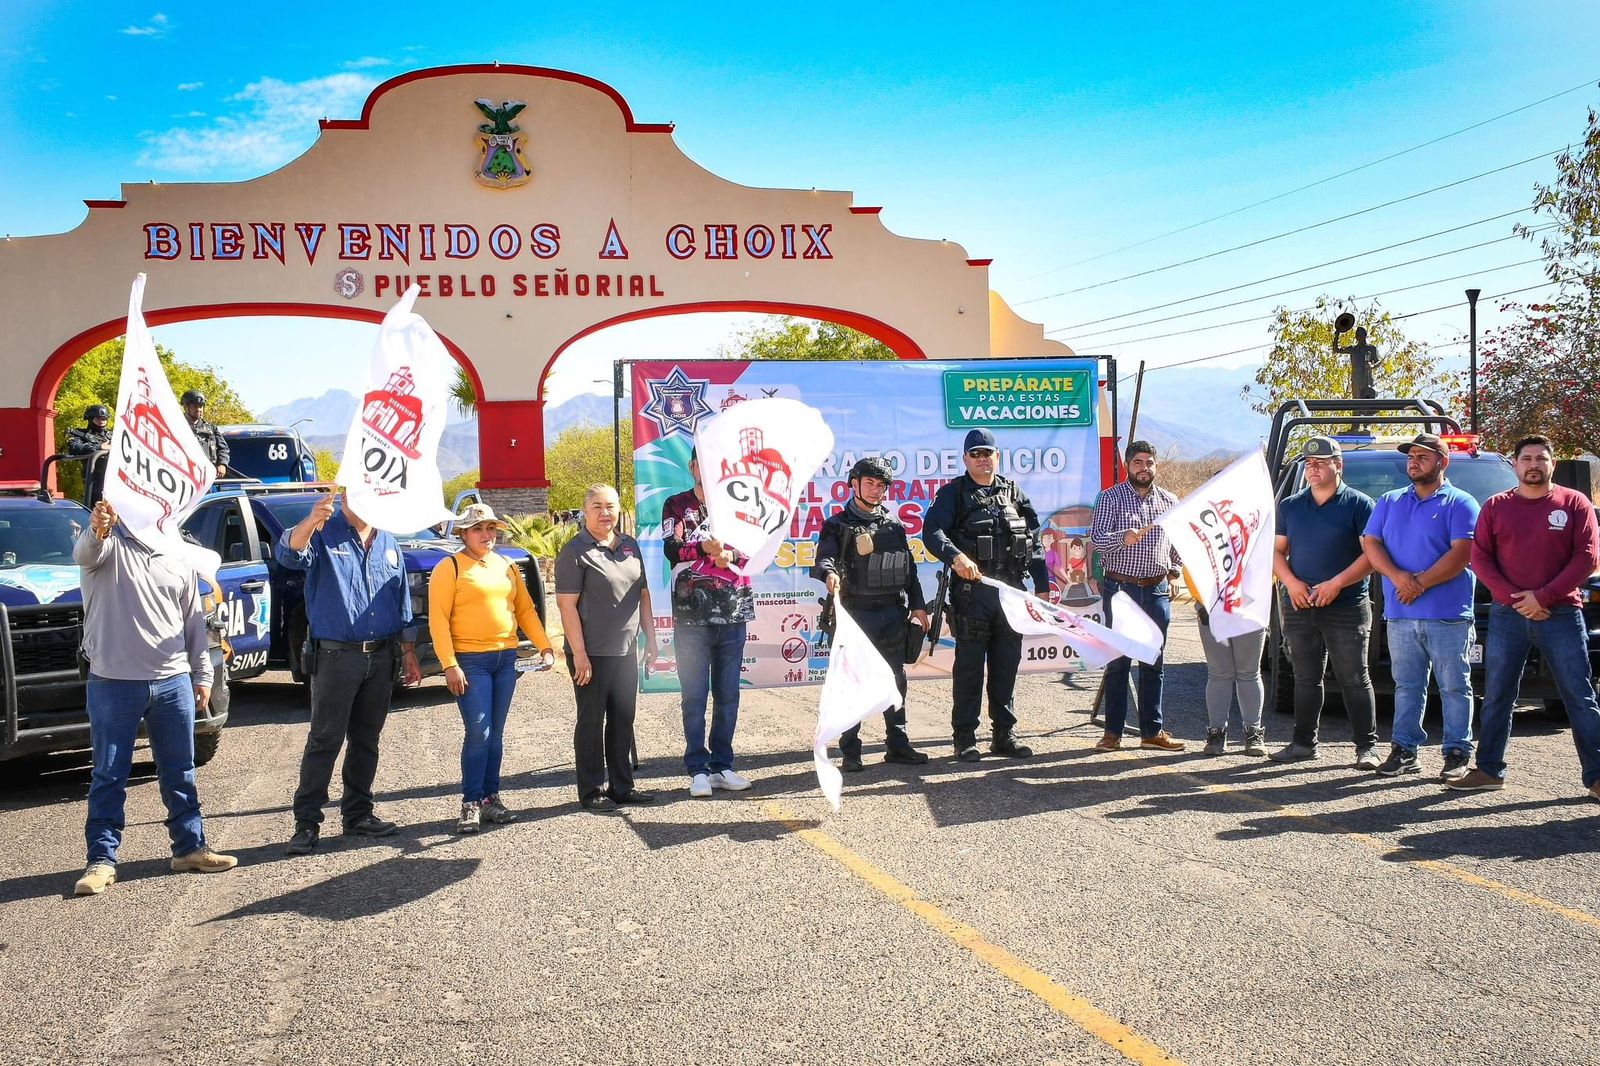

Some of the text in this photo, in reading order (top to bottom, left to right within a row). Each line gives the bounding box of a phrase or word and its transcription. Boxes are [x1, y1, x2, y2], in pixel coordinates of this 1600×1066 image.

[143, 217, 834, 266] BIENVENIDOS A CHOIX
[375, 267, 665, 298] PUEBLO SEÑORIAL
[963, 374, 1074, 392] PREPÁRATE
[979, 393, 1060, 402] PARA ESTAS
[959, 404, 1081, 420] VACACIONES
[268, 443, 288, 461] 68
[916, 448, 960, 476] DE
[998, 446, 1067, 475] ICIO
[756, 598, 799, 606] mascotas.
[773, 590, 815, 599] resguardo
[230, 651, 267, 672] SINA
[1027, 646, 1058, 661] 109
